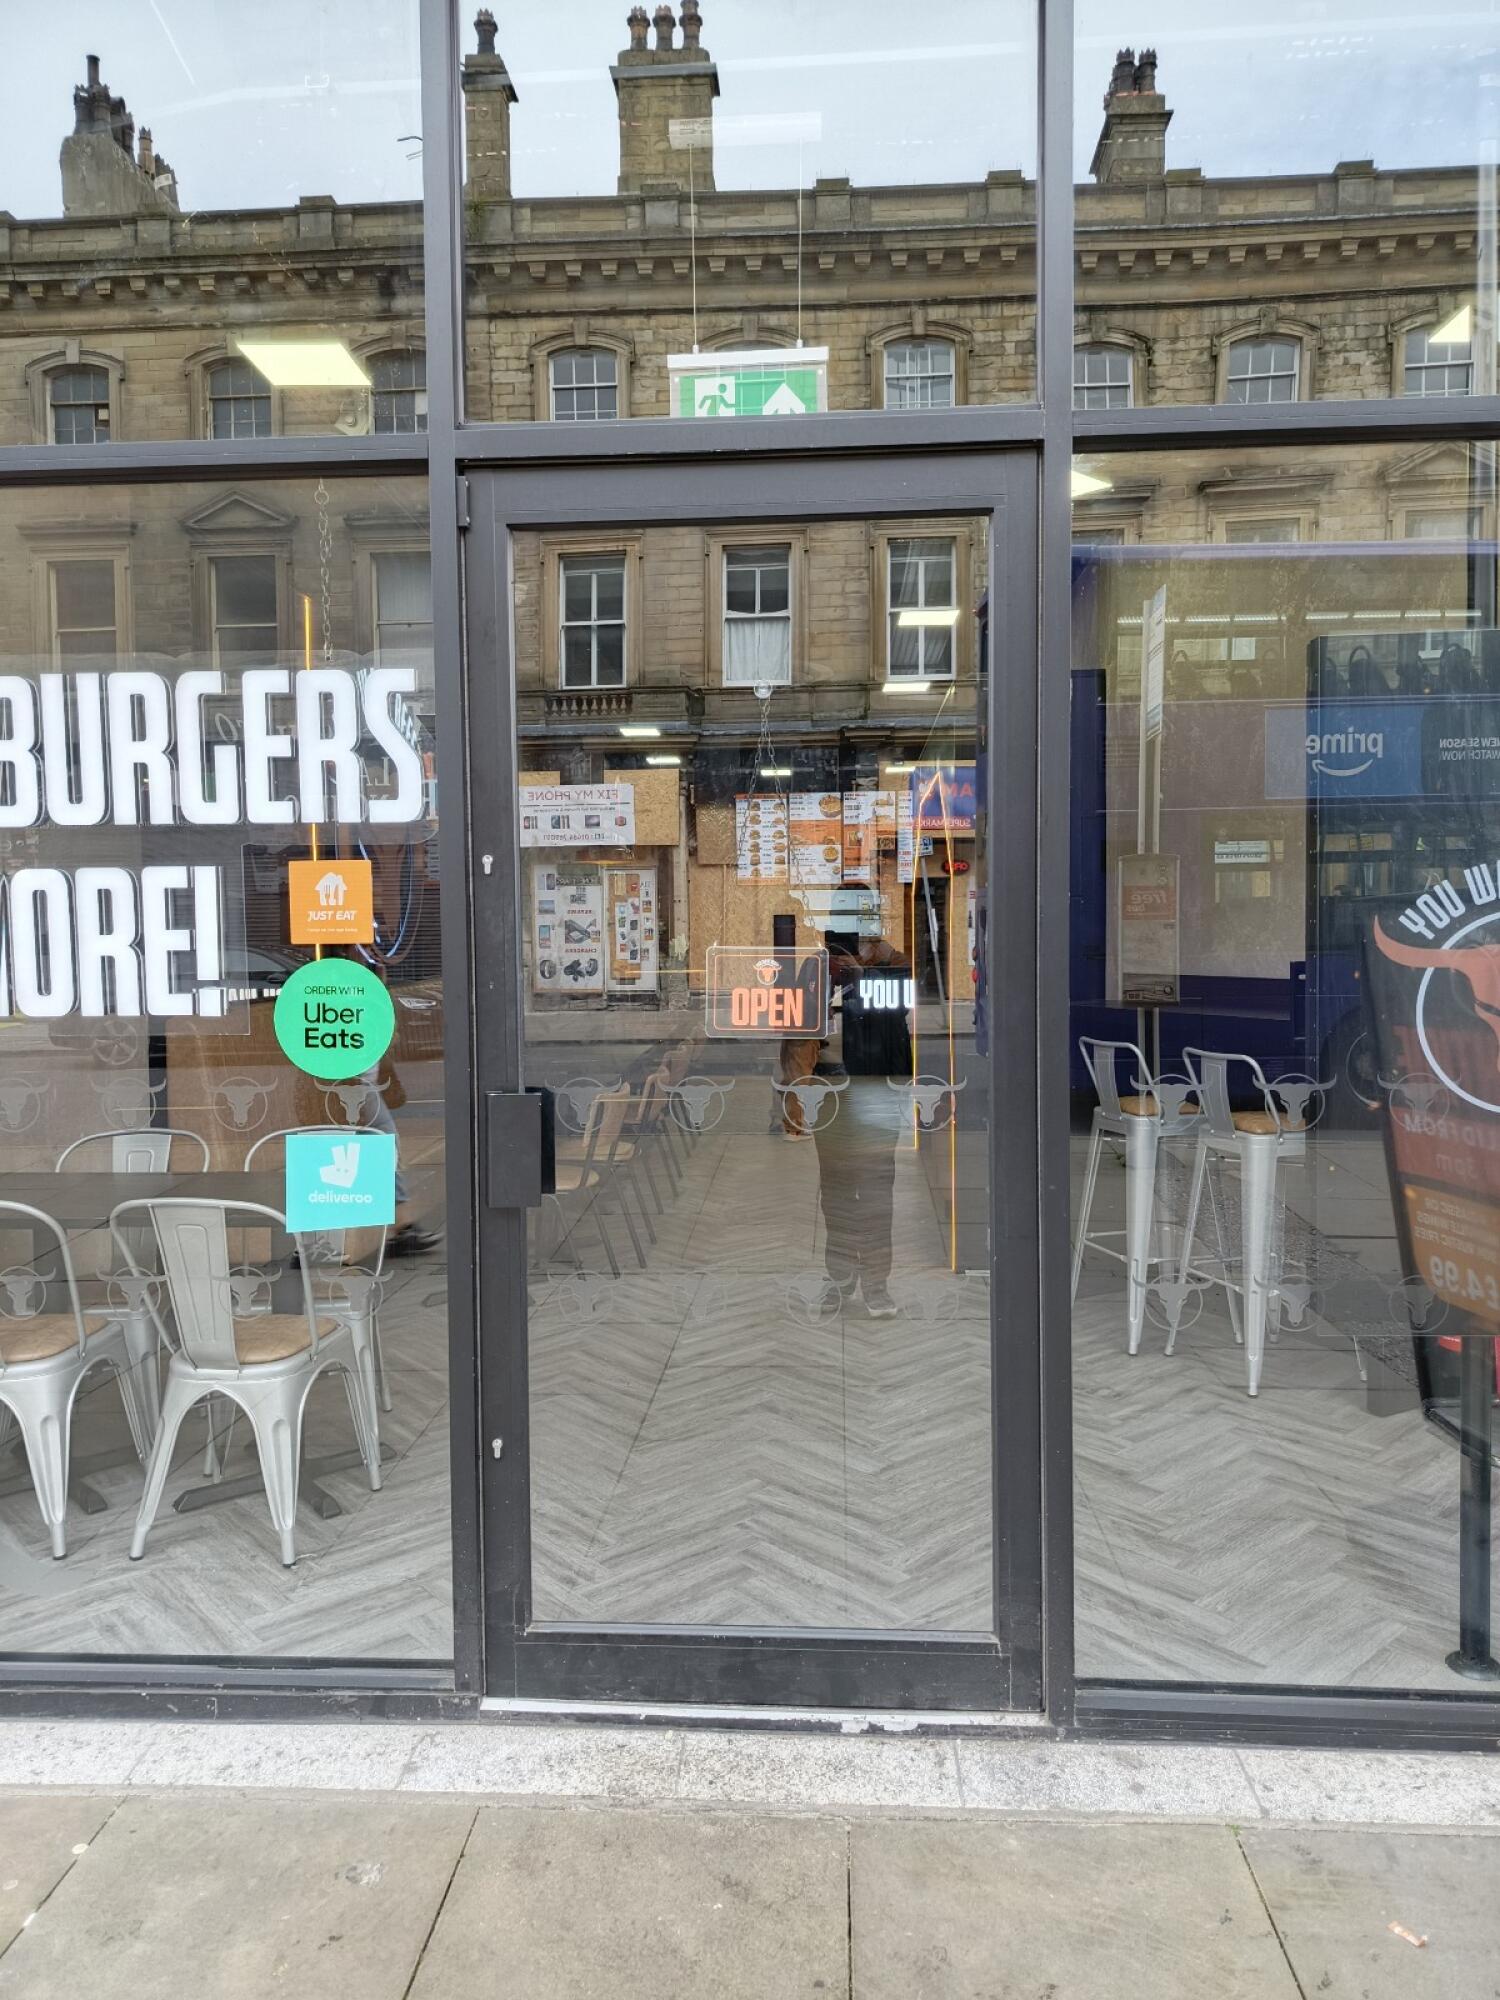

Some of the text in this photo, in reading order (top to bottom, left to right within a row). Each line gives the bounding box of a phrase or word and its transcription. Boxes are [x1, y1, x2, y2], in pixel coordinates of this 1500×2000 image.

[0, 669, 425, 826] BURGERS
[307, 910, 358, 922] JUST EAT
[1398, 879, 1466, 940] YOU
[304, 985, 365, 996] ORDER WITH
[859, 979, 899, 1009] YOU
[304, 1002, 365, 1024] Uber
[731, 987, 804, 1027] OPEN
[304, 1027, 365, 1049] Eats
[308, 1189, 373, 1204] deliveroo
